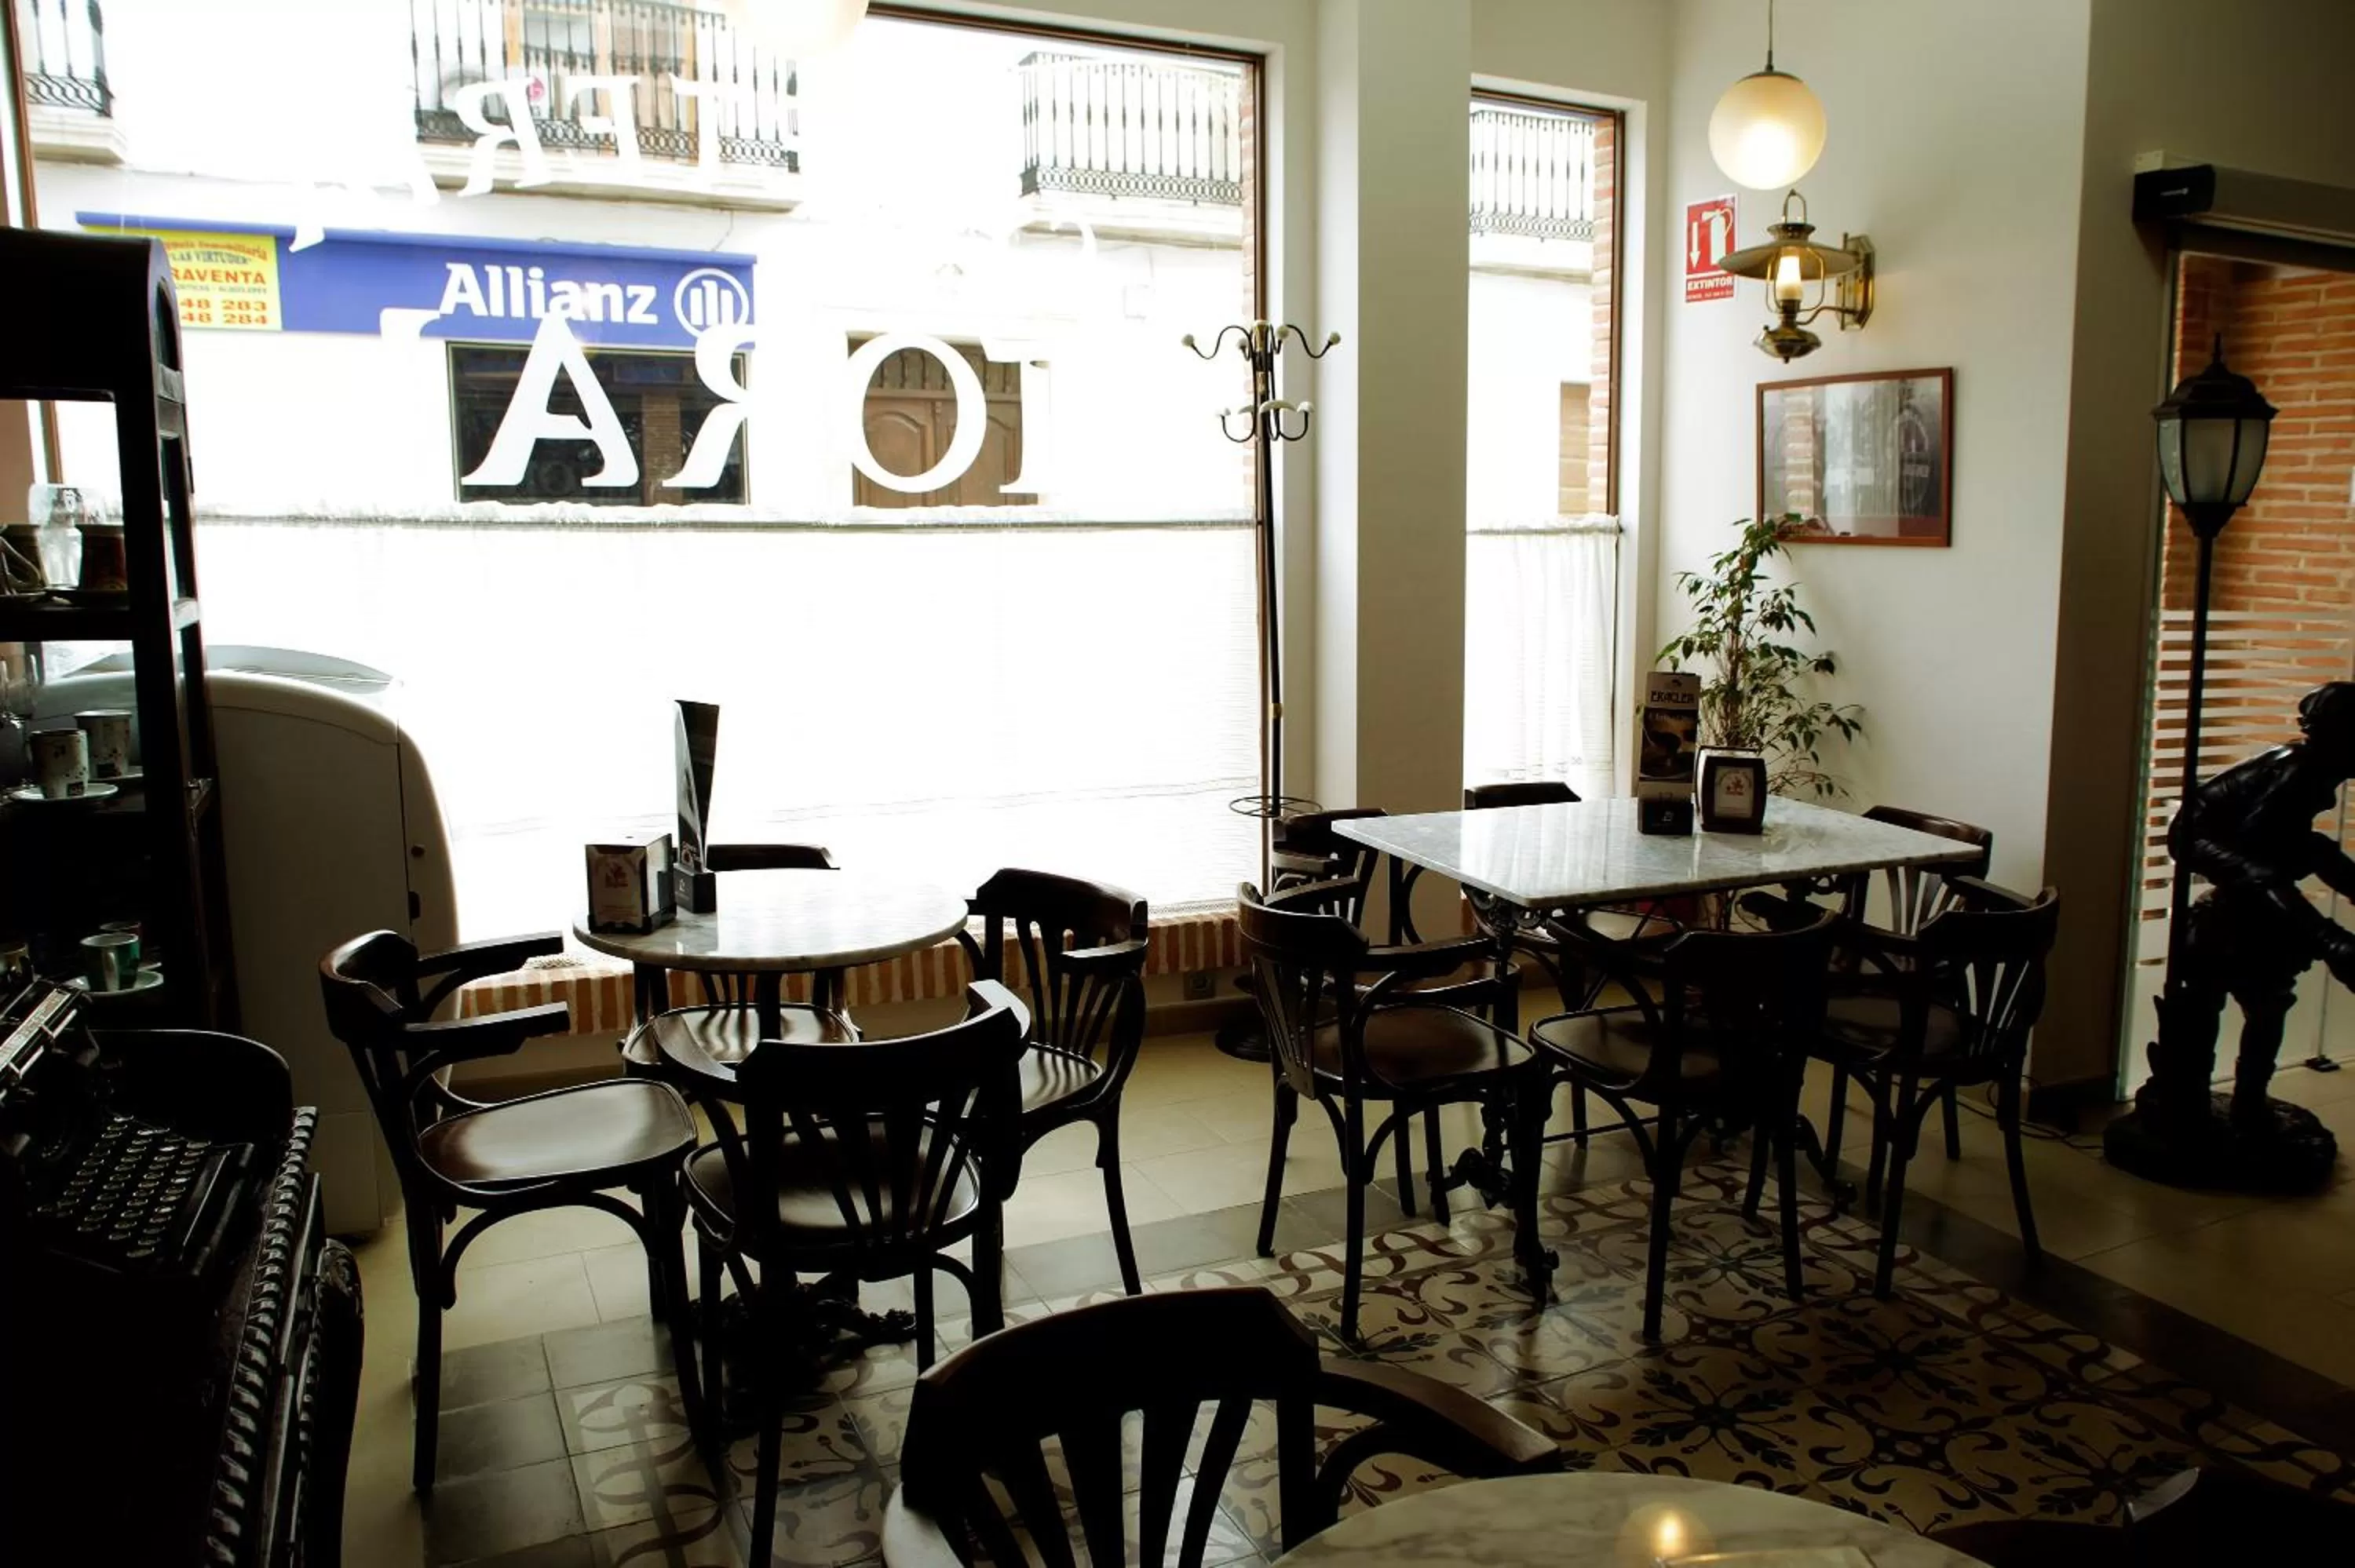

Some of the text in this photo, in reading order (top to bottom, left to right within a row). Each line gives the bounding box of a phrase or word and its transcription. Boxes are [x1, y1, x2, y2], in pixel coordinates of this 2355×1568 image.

[170, 267, 267, 284] RAVENTA
[1687, 276, 1733, 291] EXTINTOR
[440, 263, 658, 324] Allianz
